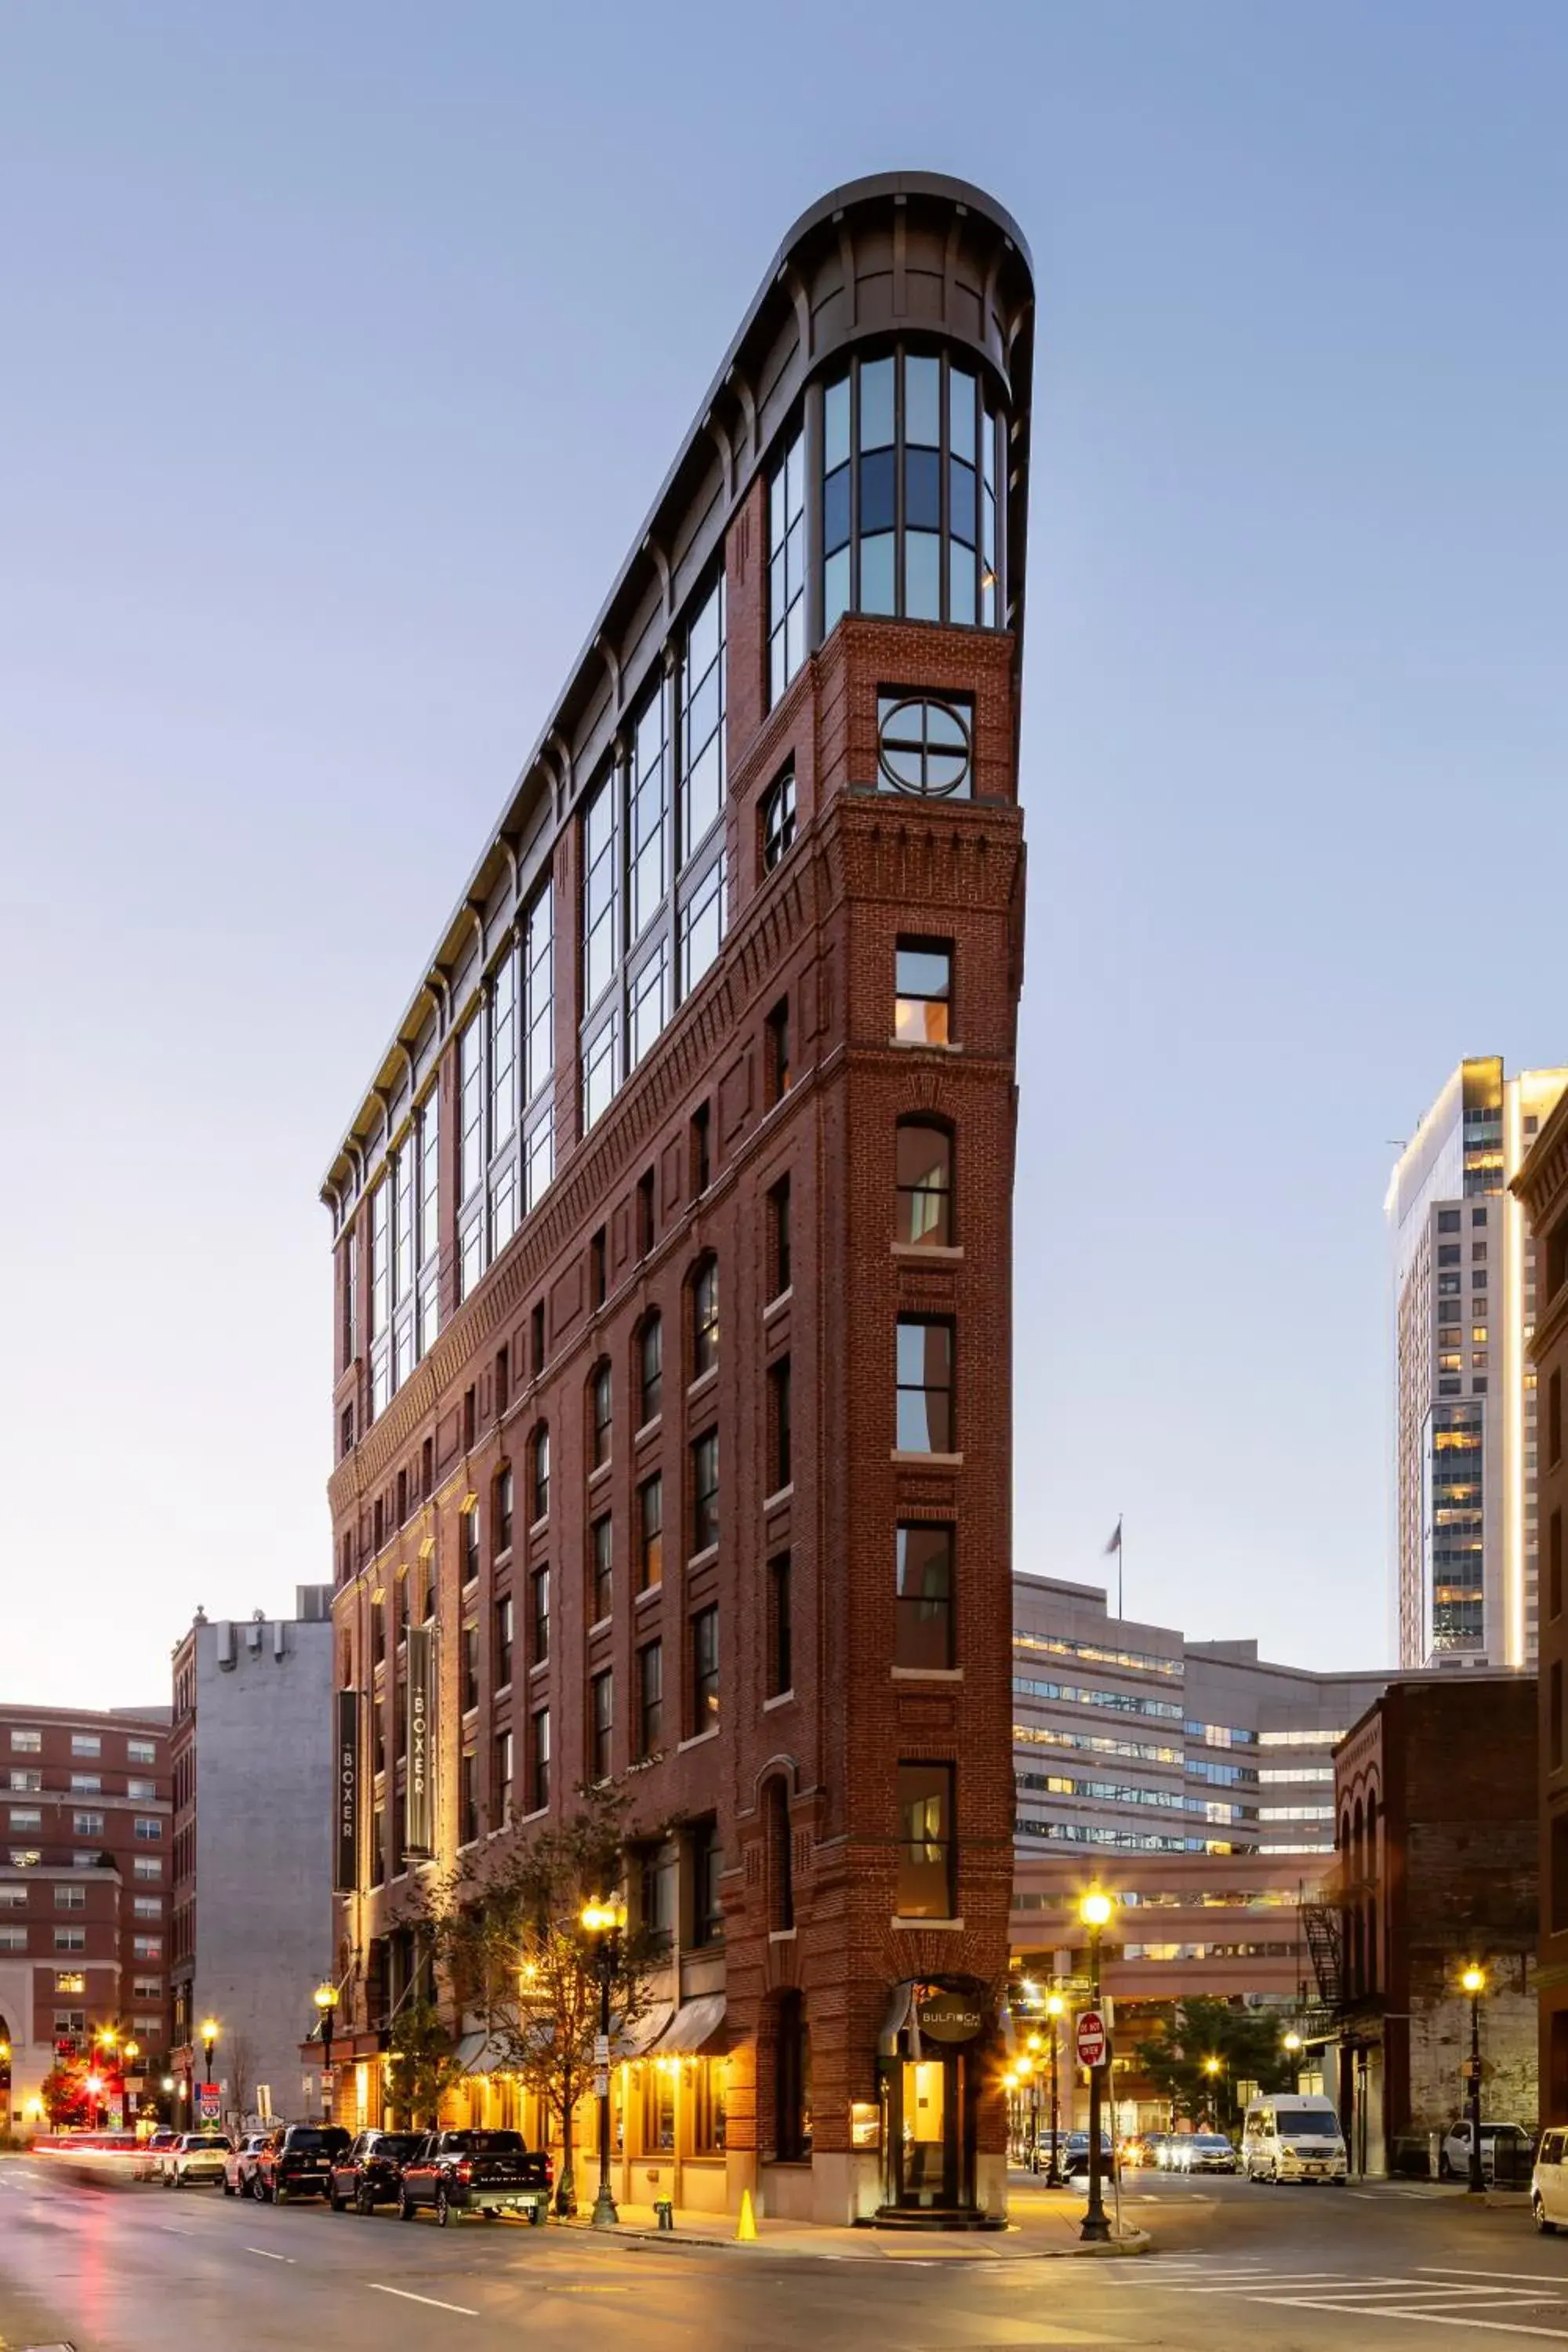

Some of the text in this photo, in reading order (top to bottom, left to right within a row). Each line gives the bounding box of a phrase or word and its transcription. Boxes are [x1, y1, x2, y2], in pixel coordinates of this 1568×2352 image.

[413, 1697, 426, 1795] BOXER
[343, 1752, 354, 1837] BOXER
[205, 2107, 217, 2115] 93
